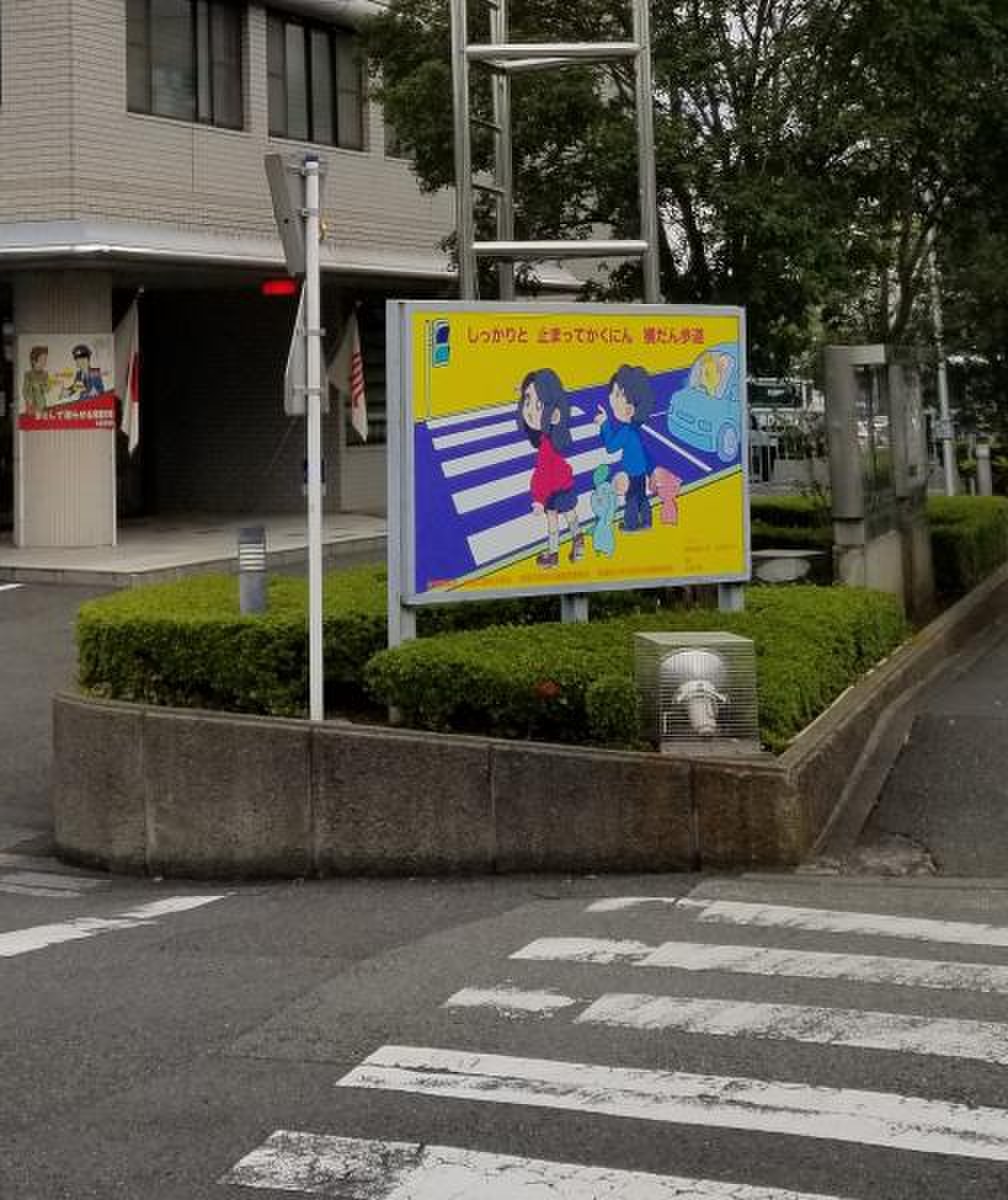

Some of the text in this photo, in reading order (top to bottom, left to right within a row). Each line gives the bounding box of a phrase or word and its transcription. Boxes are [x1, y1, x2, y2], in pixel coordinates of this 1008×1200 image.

[467, 325, 529, 344] しっかりと
[536, 325, 634, 344] 止まってかくにん
